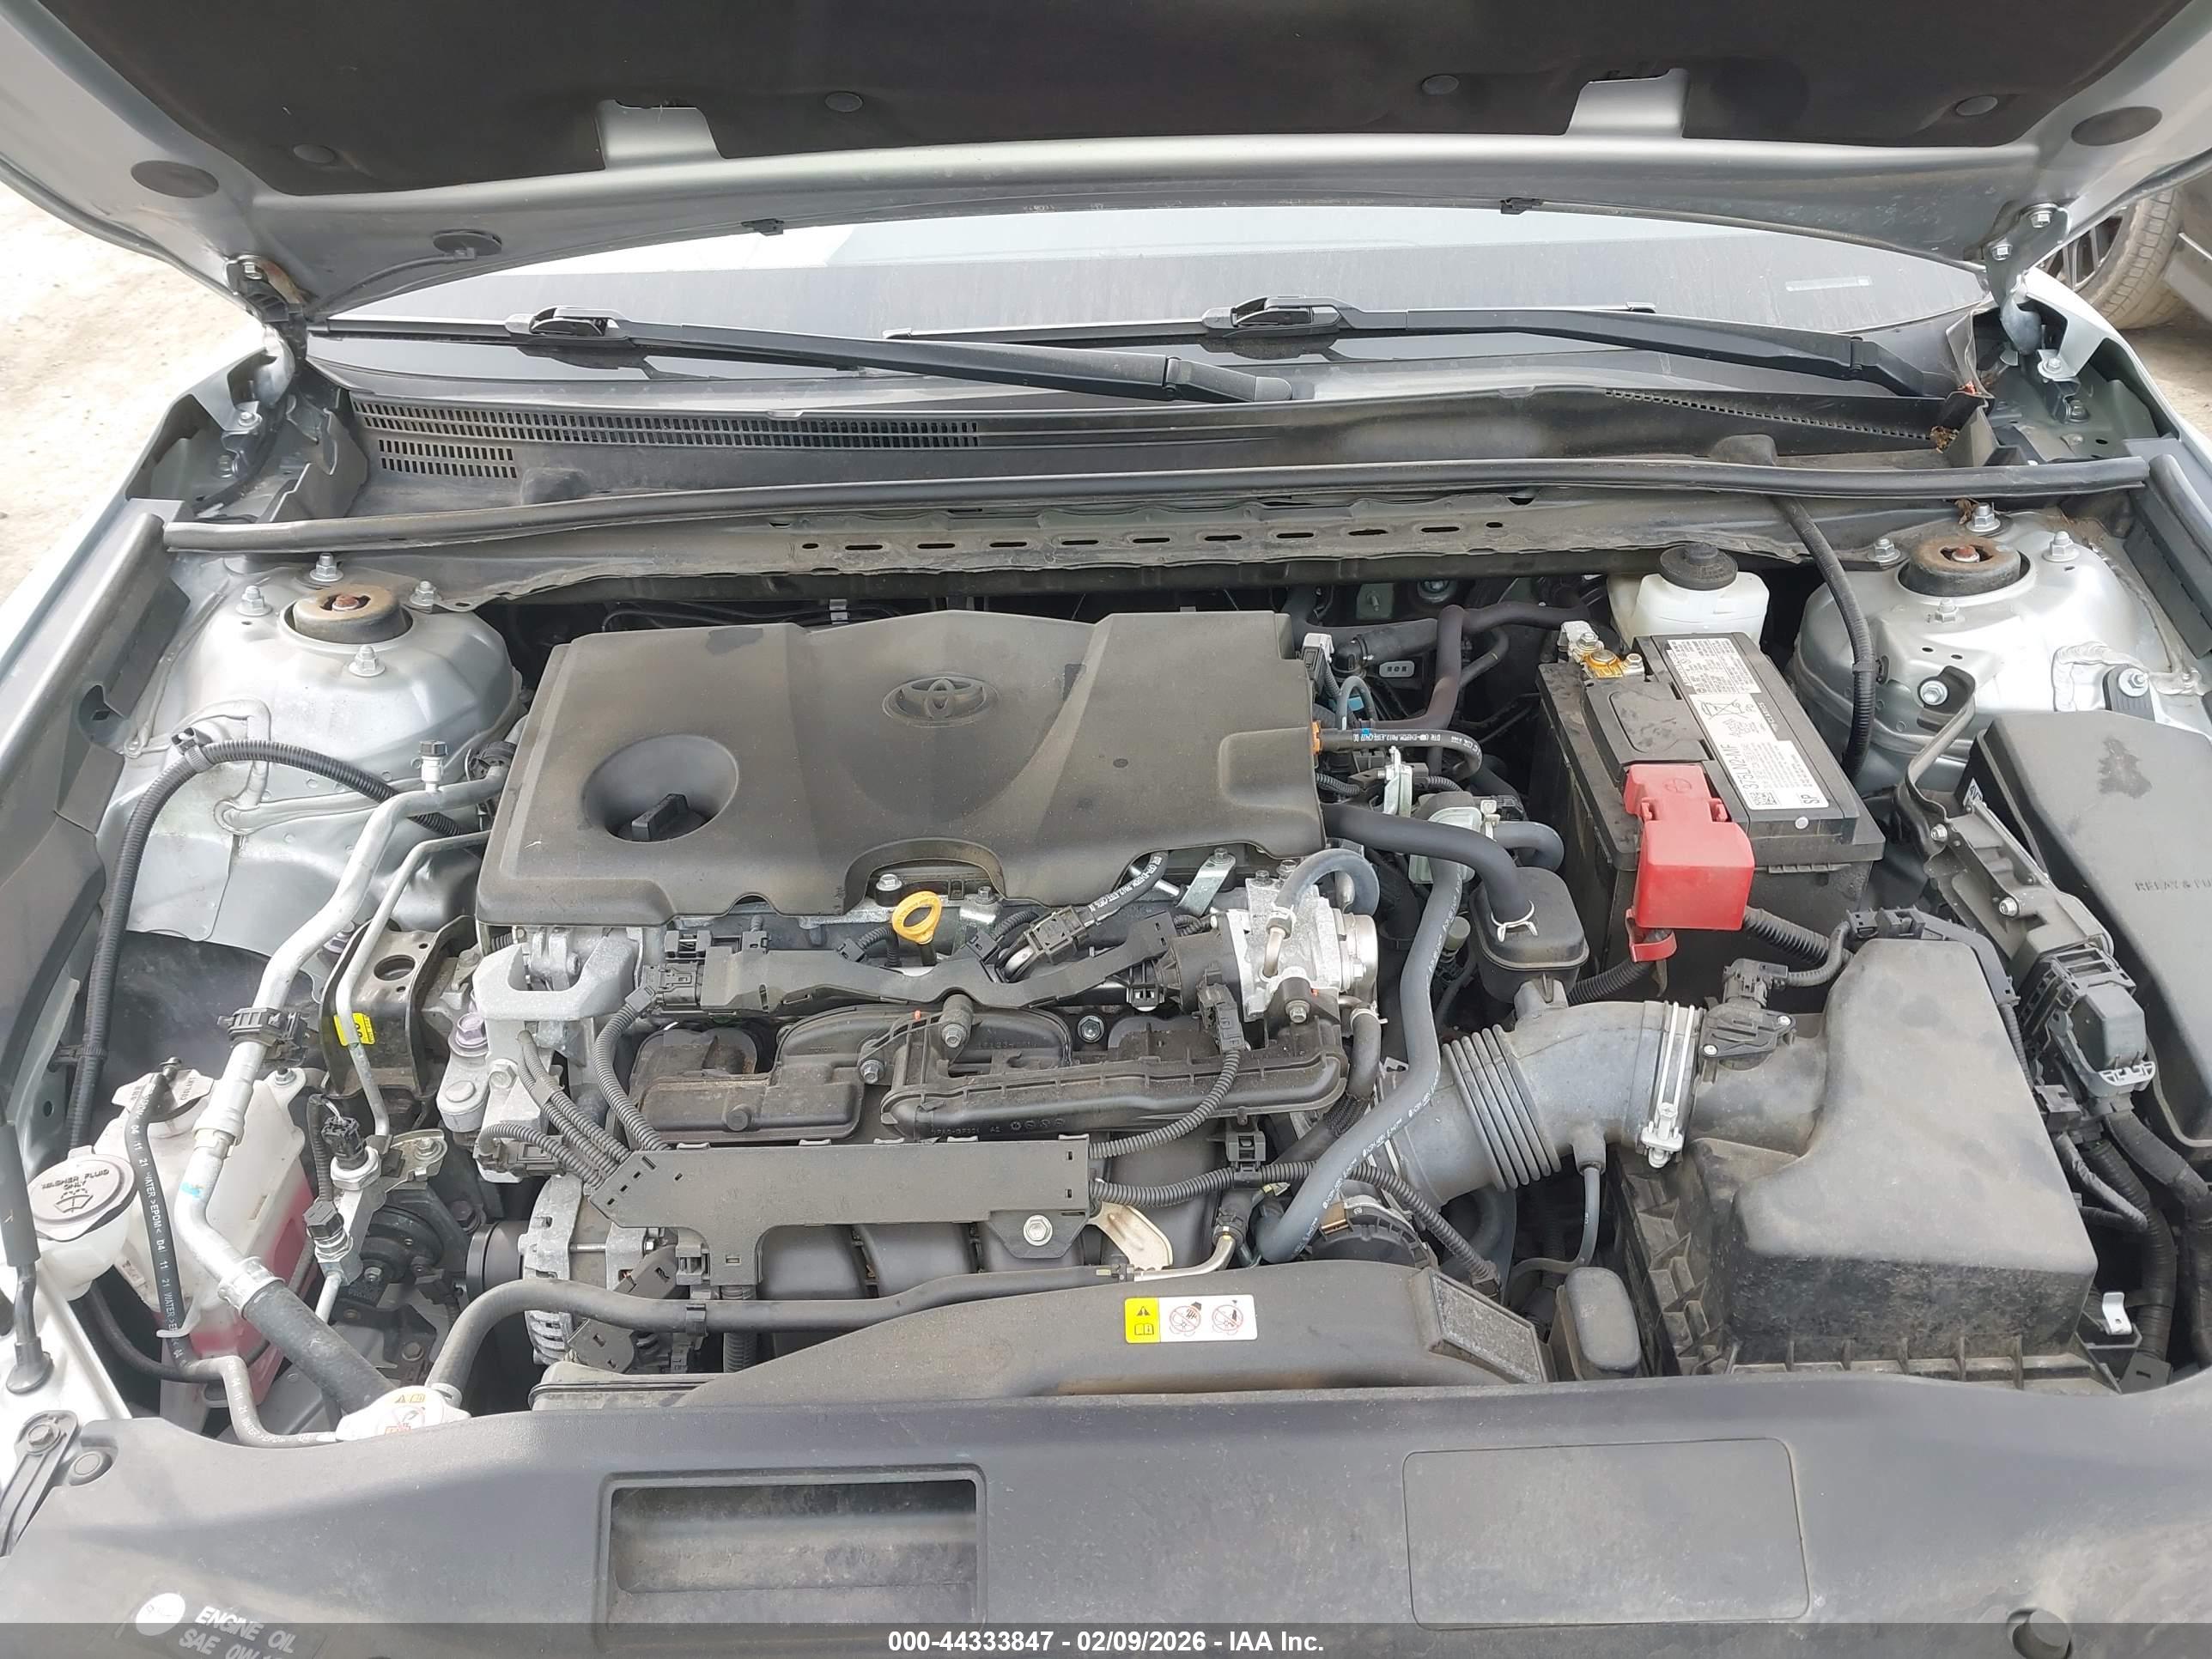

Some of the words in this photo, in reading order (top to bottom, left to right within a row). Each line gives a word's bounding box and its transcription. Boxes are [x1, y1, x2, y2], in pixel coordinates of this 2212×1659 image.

[1720, 744, 1759, 791] 375LN2-MF
[1801, 794, 1820, 804] SP
[84, 1169, 110, 1181] FLUID
[63, 1180, 87, 1191] ONLY
[195, 1606, 264, 1641] ENGINE
[267, 1631, 297, 1654] OIL
[179, 1628, 222, 1656] SAE
